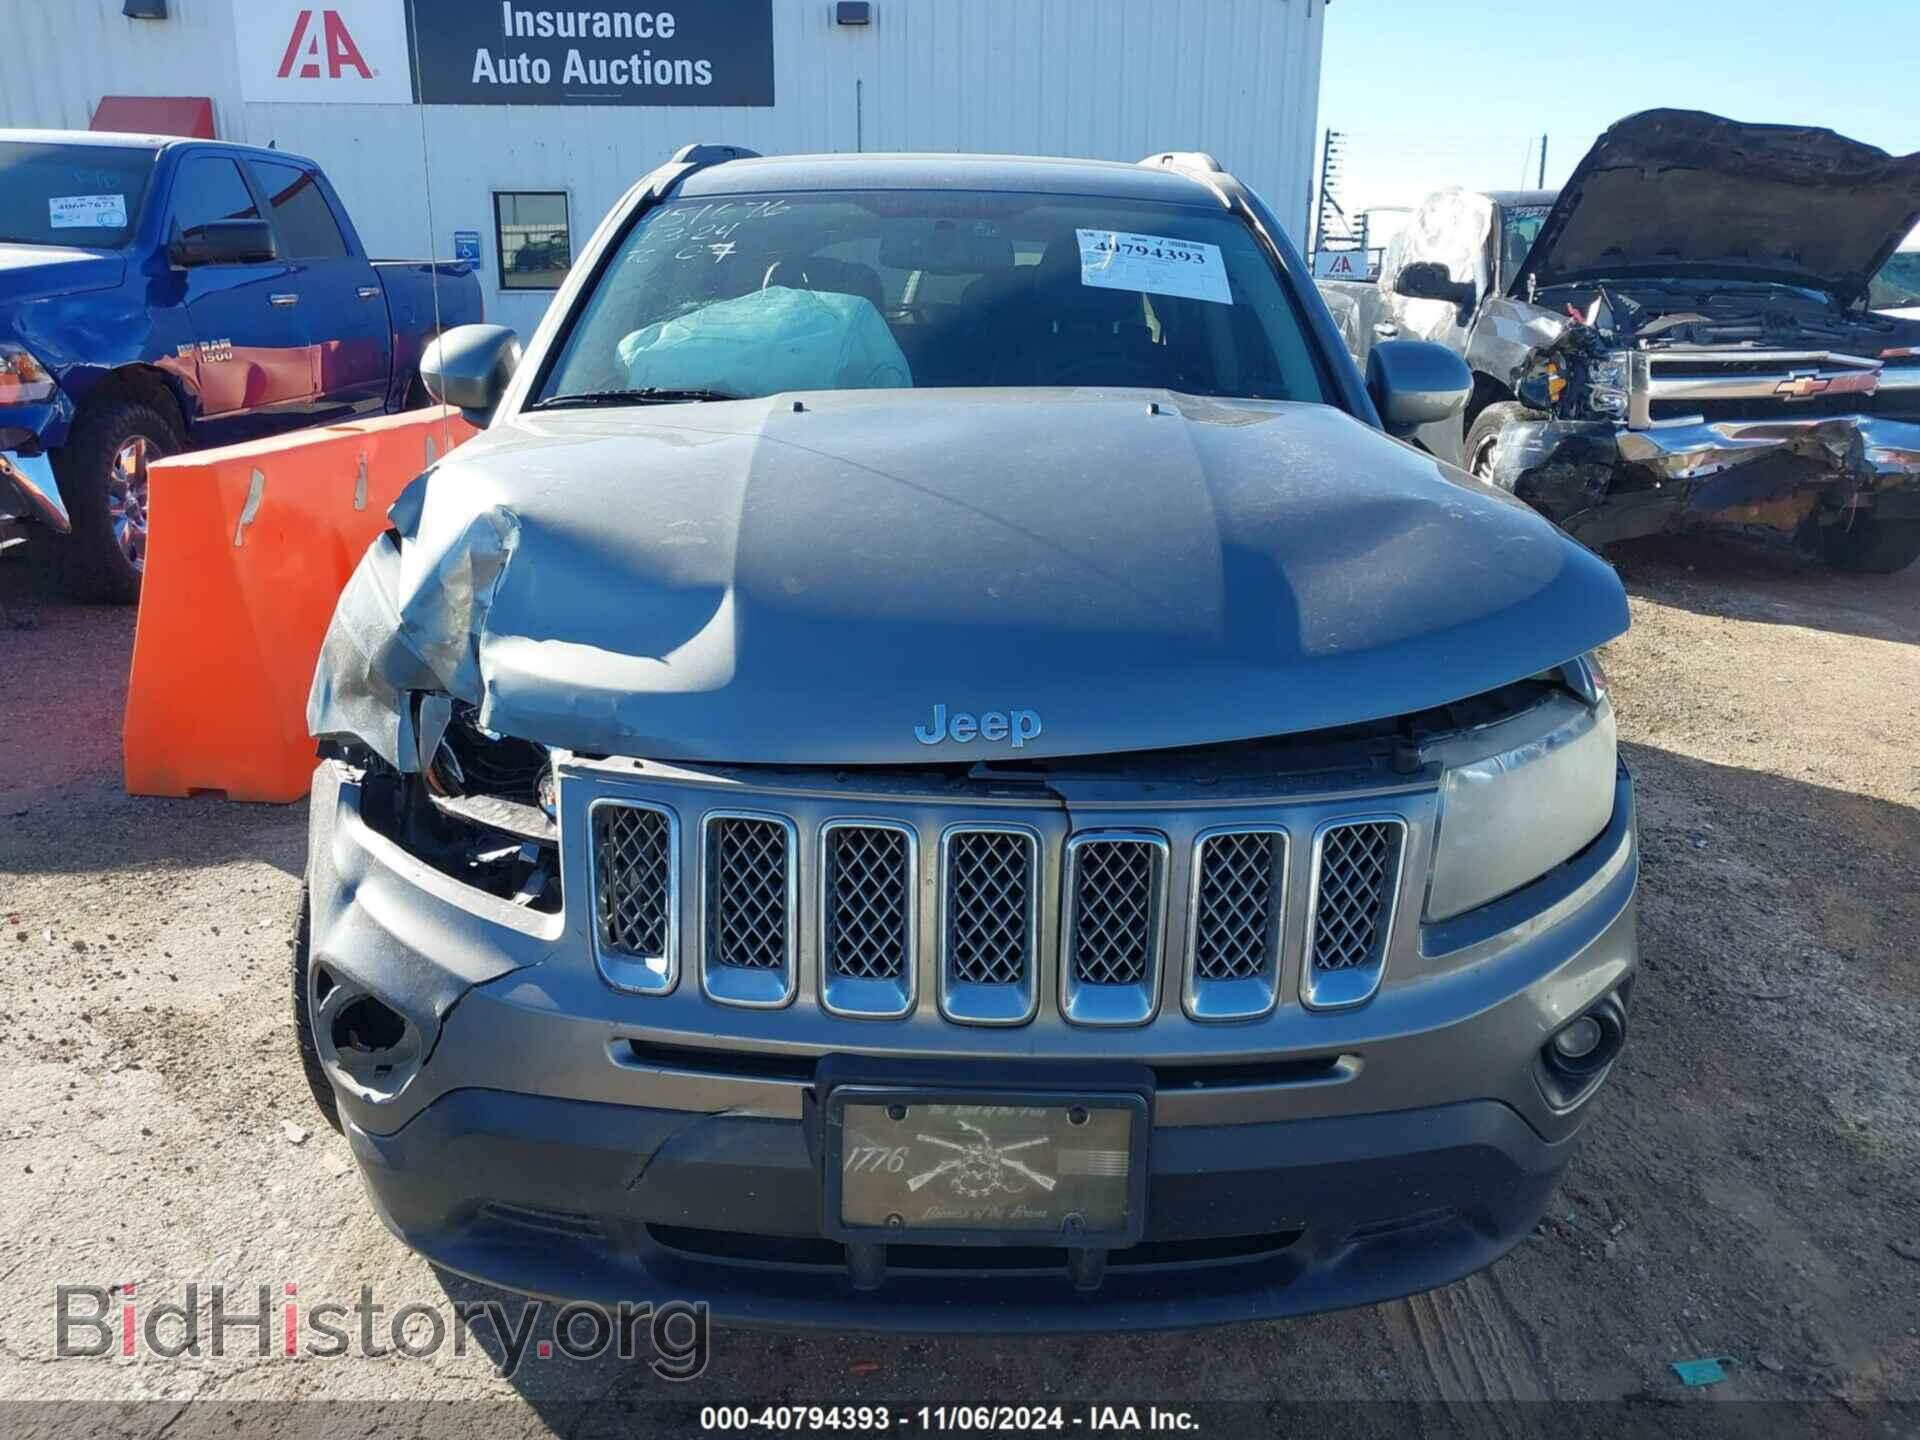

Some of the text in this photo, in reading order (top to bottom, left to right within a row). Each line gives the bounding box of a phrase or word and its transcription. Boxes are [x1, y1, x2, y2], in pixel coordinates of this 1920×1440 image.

[503, 1, 676, 38] Insurance
[472, 48, 713, 86] Auto Auctions
[1094, 240, 1206, 265] 40794393
[200, 338, 232, 352] RAM
[202, 350, 233, 363] 1500
[914, 703, 1042, 748] Jeep
[843, 1146, 910, 1173] 1776
